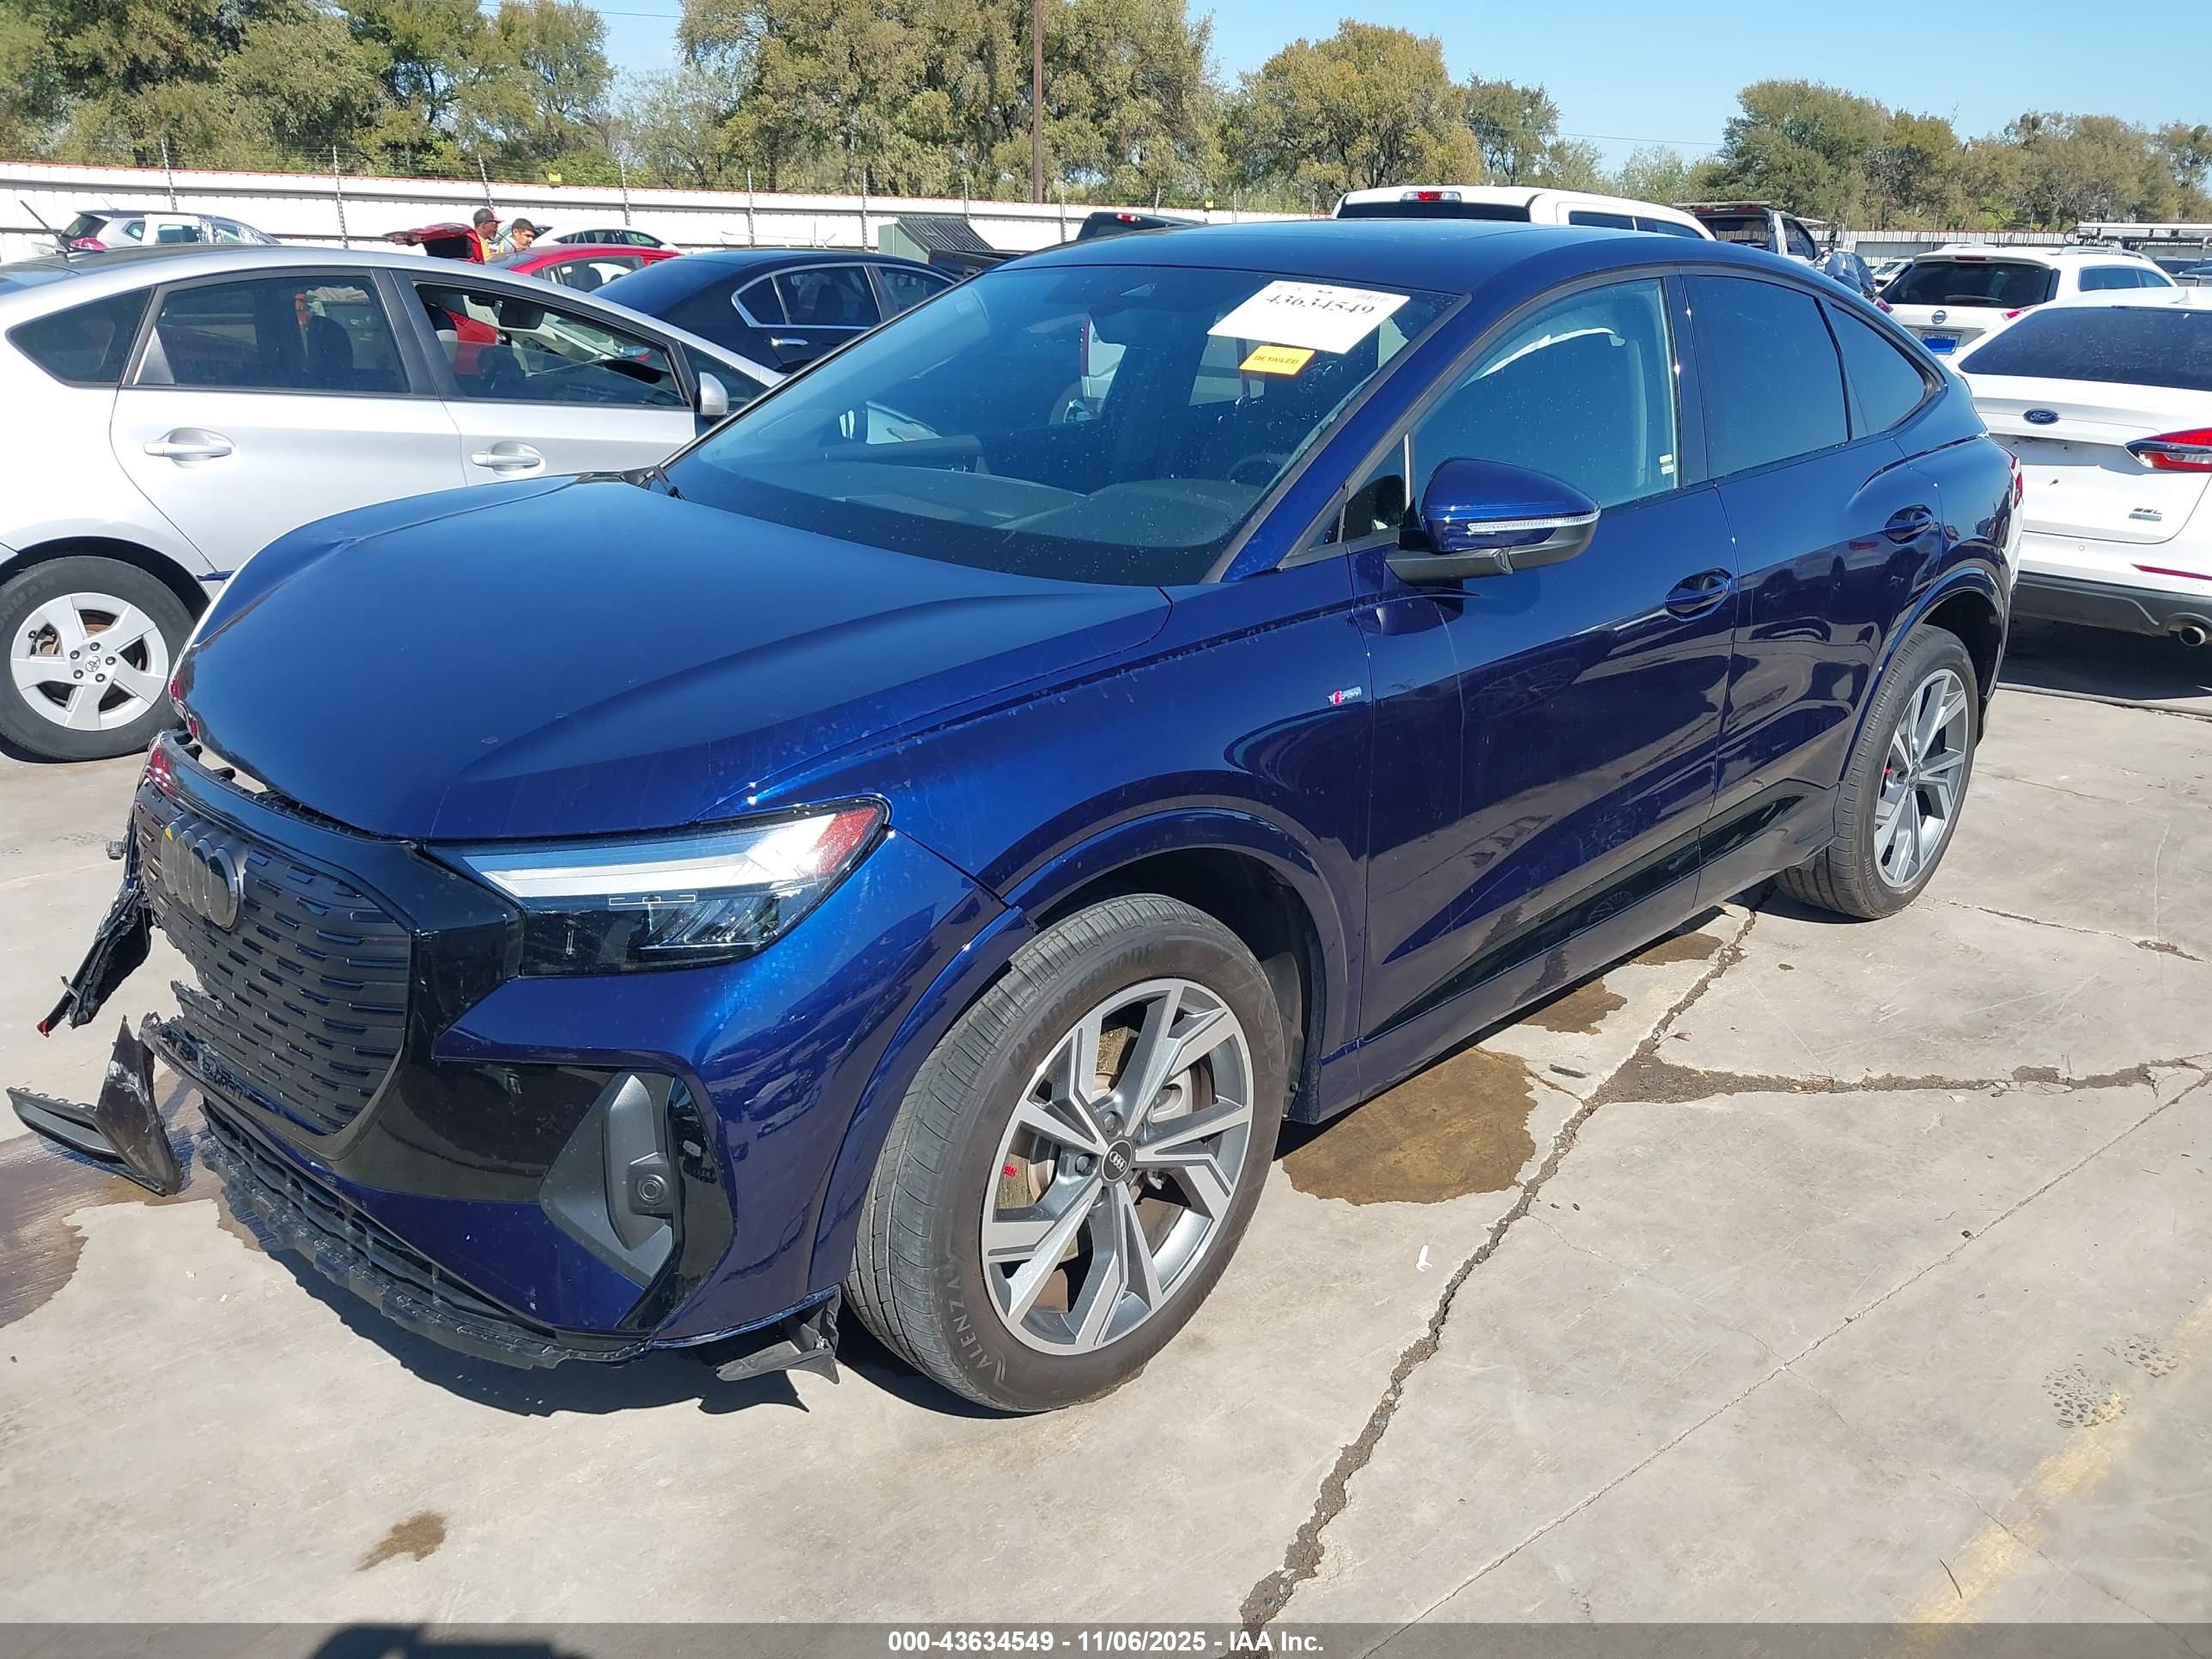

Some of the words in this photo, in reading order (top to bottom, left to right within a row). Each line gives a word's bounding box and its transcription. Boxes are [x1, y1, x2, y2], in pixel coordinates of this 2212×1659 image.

[1266, 295, 1376, 314] 43634549
[1254, 356, 1299, 365] DETAILED
[946, 1274, 994, 1369] ALENZA
